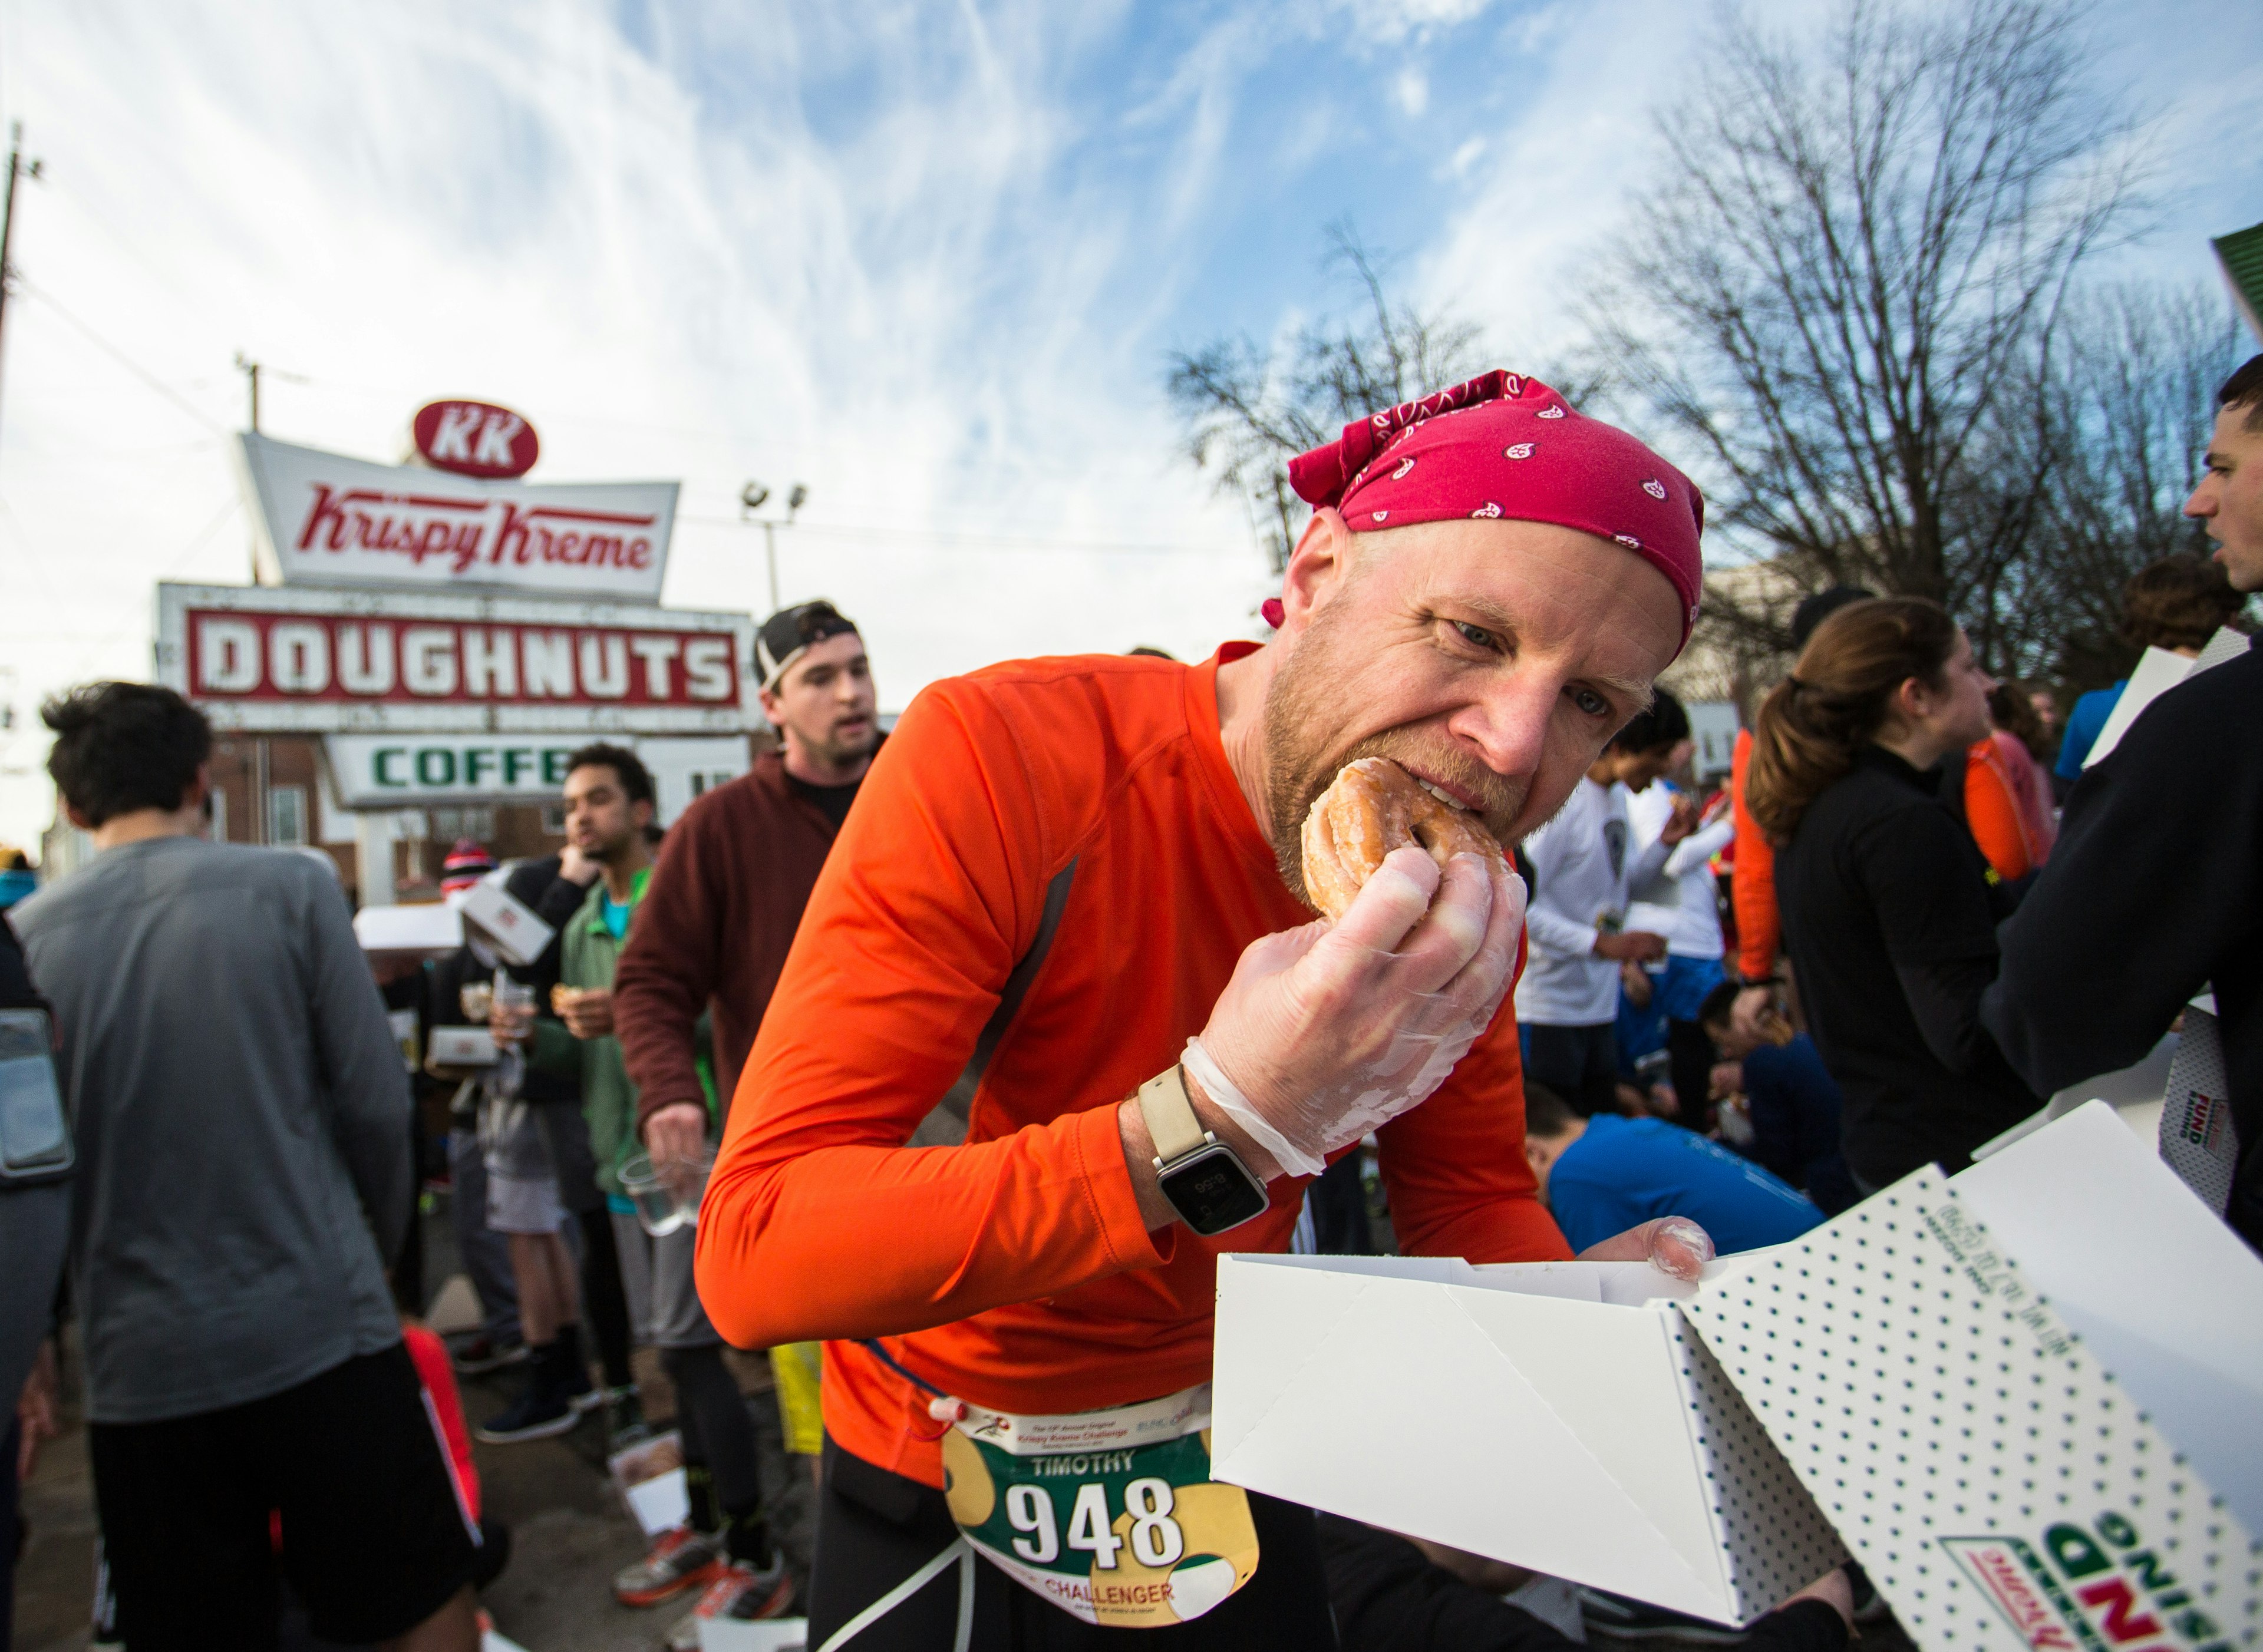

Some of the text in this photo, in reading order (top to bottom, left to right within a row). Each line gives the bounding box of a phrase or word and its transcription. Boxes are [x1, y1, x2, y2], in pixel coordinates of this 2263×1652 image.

[428, 405, 523, 467] KK
[296, 481, 656, 574] Krispy Kreme
[196, 616, 735, 701] DOUGHNUTS
[372, 746, 572, 788] COFFE
[2189, 1093, 2211, 1144] FUND
[1017, 1428, 1129, 1444] Krispy Kreme Challenge
[1031, 1449, 1136, 1476] TIMOTHY
[1005, 1477, 1184, 1570] 948
[1045, 1577, 1176, 1605] CHALLENGER
[2043, 1520, 2183, 1652] ND
